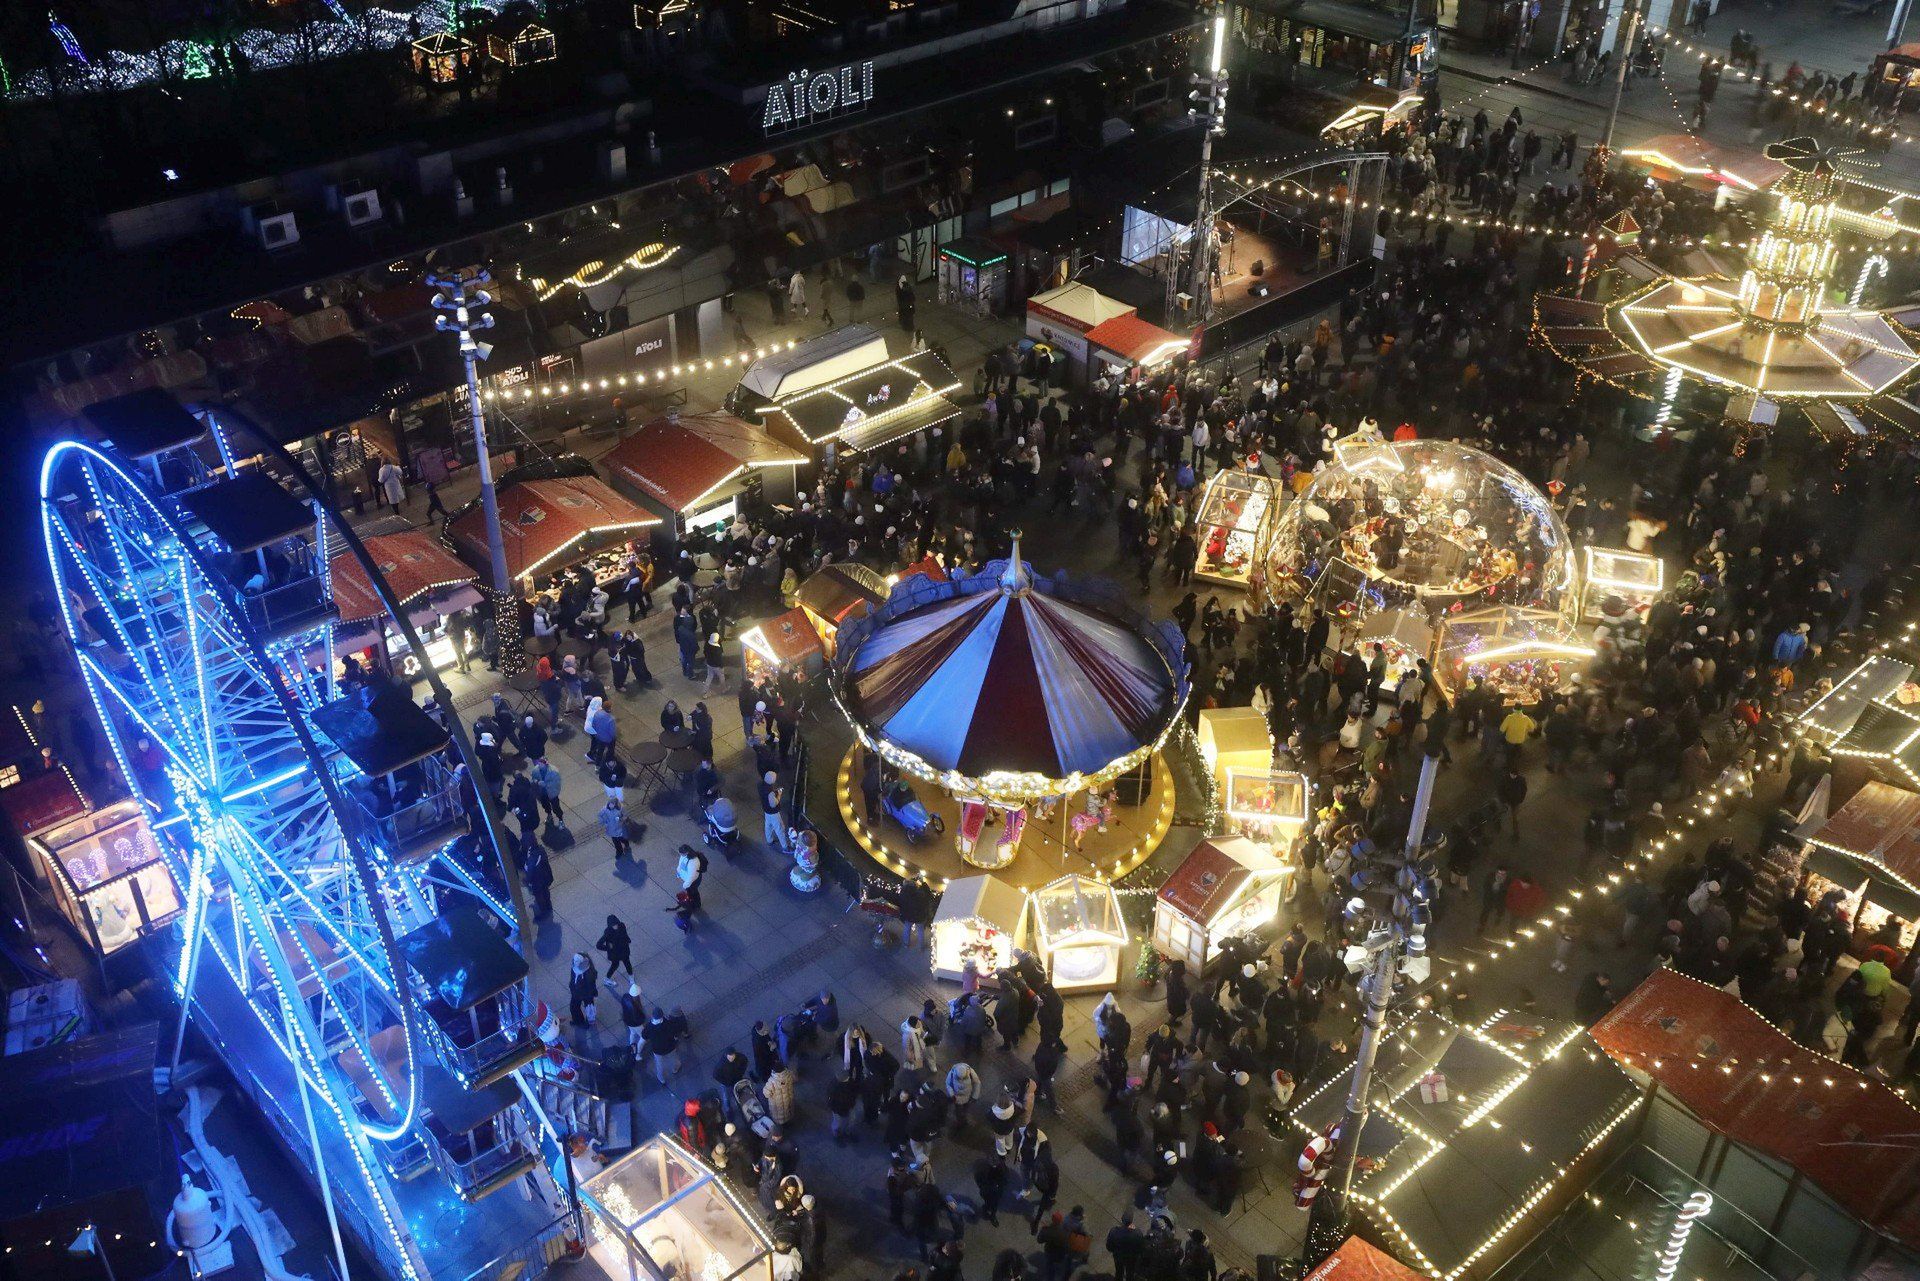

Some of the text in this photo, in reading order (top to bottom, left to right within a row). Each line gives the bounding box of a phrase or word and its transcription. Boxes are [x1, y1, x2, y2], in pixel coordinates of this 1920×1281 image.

[763, 61, 873, 127] AÏOLI
[635, 339, 663, 356] AÏOLI
[502, 371, 529, 387] AÏOLI
